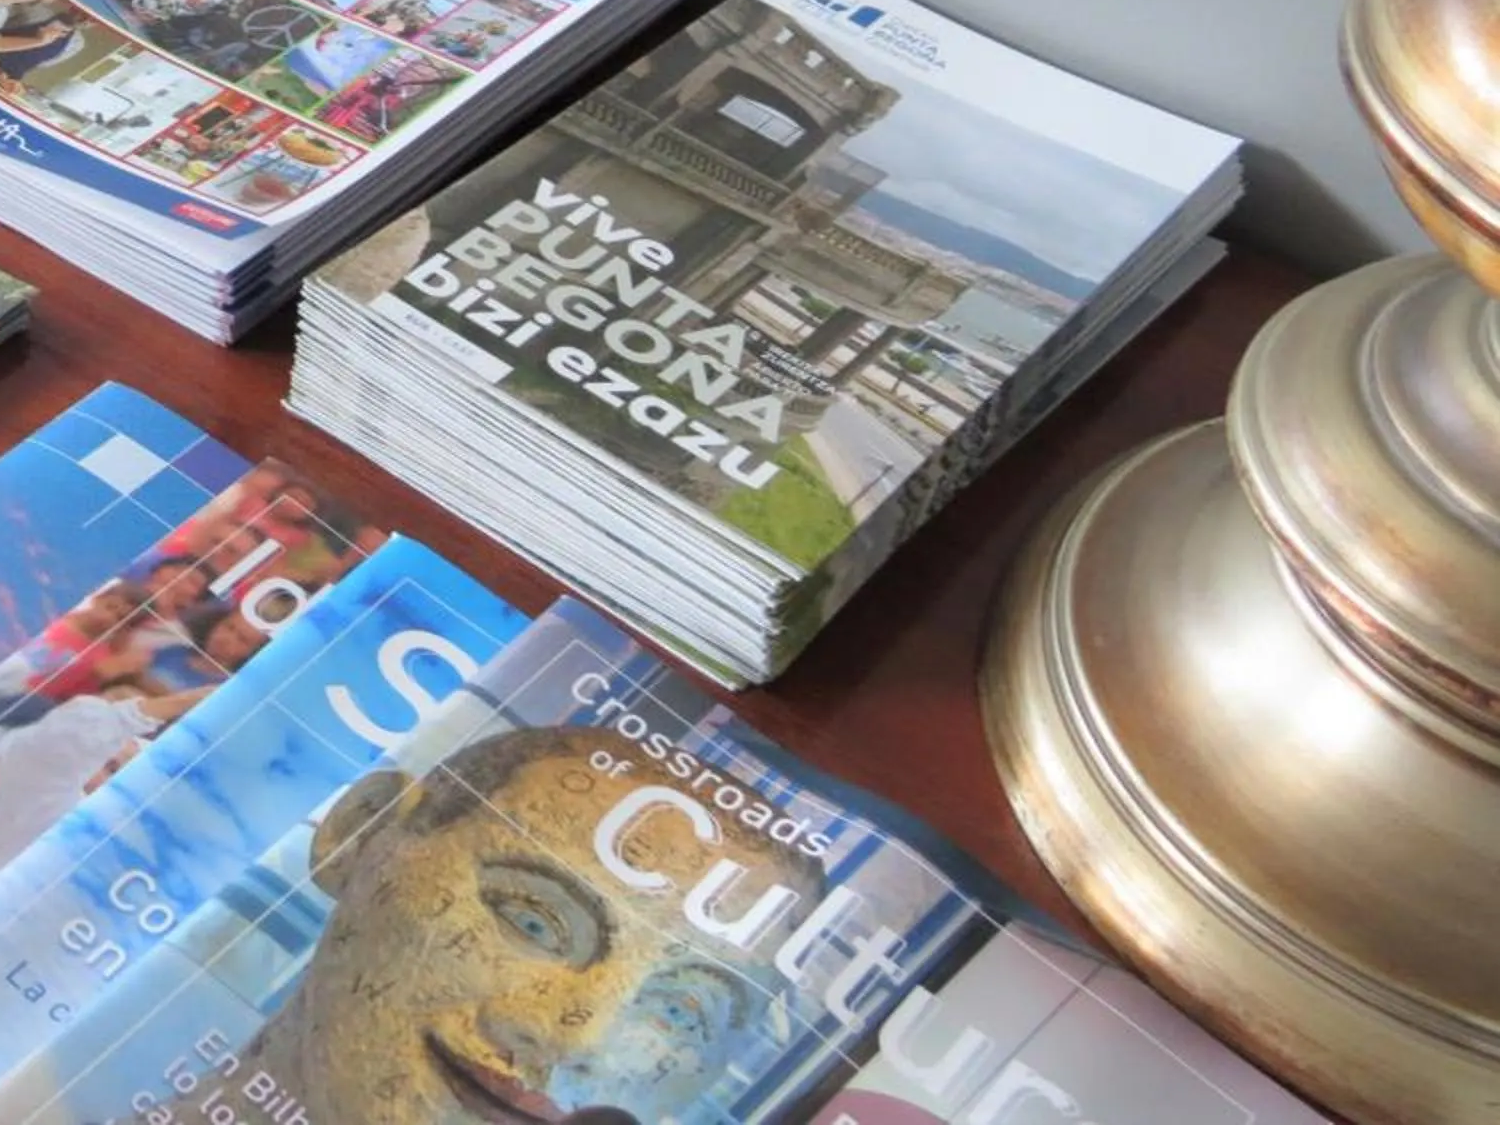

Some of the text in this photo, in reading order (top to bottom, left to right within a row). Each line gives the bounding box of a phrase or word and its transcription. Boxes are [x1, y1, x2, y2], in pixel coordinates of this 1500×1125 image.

[532, 177, 675, 272] vive
[483, 199, 751, 369] PUNTA
[444, 227, 784, 444] BEGOÑA
[404, 251, 554, 349] bizi
[546, 346, 781, 490] ezazu
[571, 672, 832, 856] Crossroads
[590, 750, 635, 778] of
[107, 869, 175, 934] Co
[60, 916, 126, 979] en
[5, 960, 46, 1003] La
[164, 1057, 197, 1093] lo
[195, 1028, 240, 1076] En
